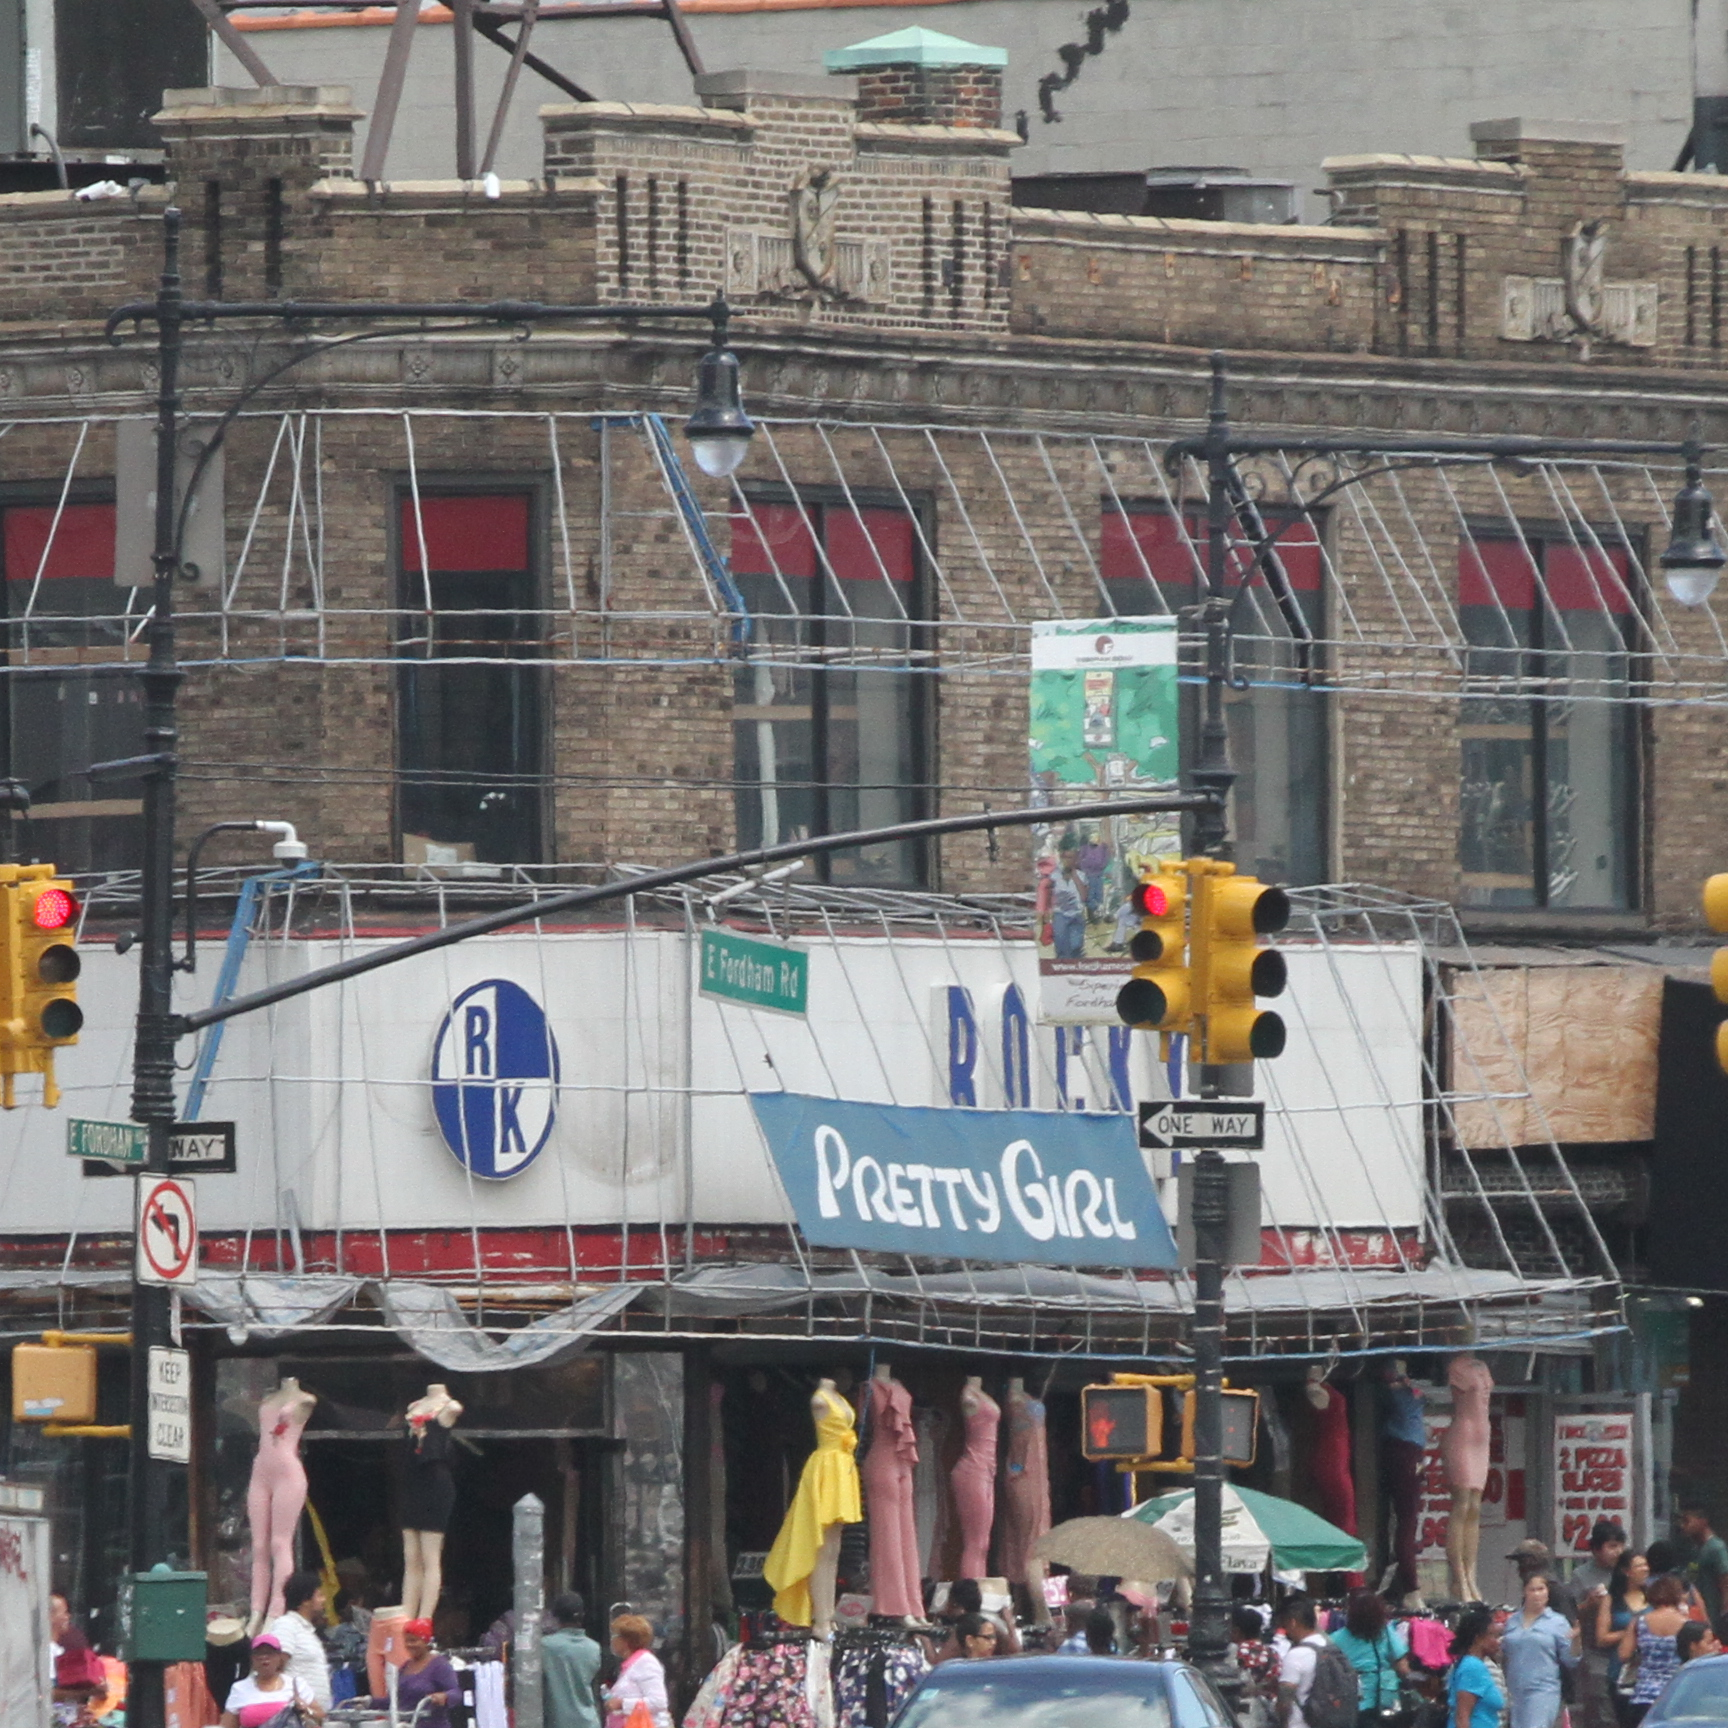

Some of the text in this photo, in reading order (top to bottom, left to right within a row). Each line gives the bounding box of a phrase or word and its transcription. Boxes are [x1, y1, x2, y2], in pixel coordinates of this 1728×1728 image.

[706, 943, 800, 999] E Fordham Rd
[1157, 1115, 1249, 1136] ONE WAY
